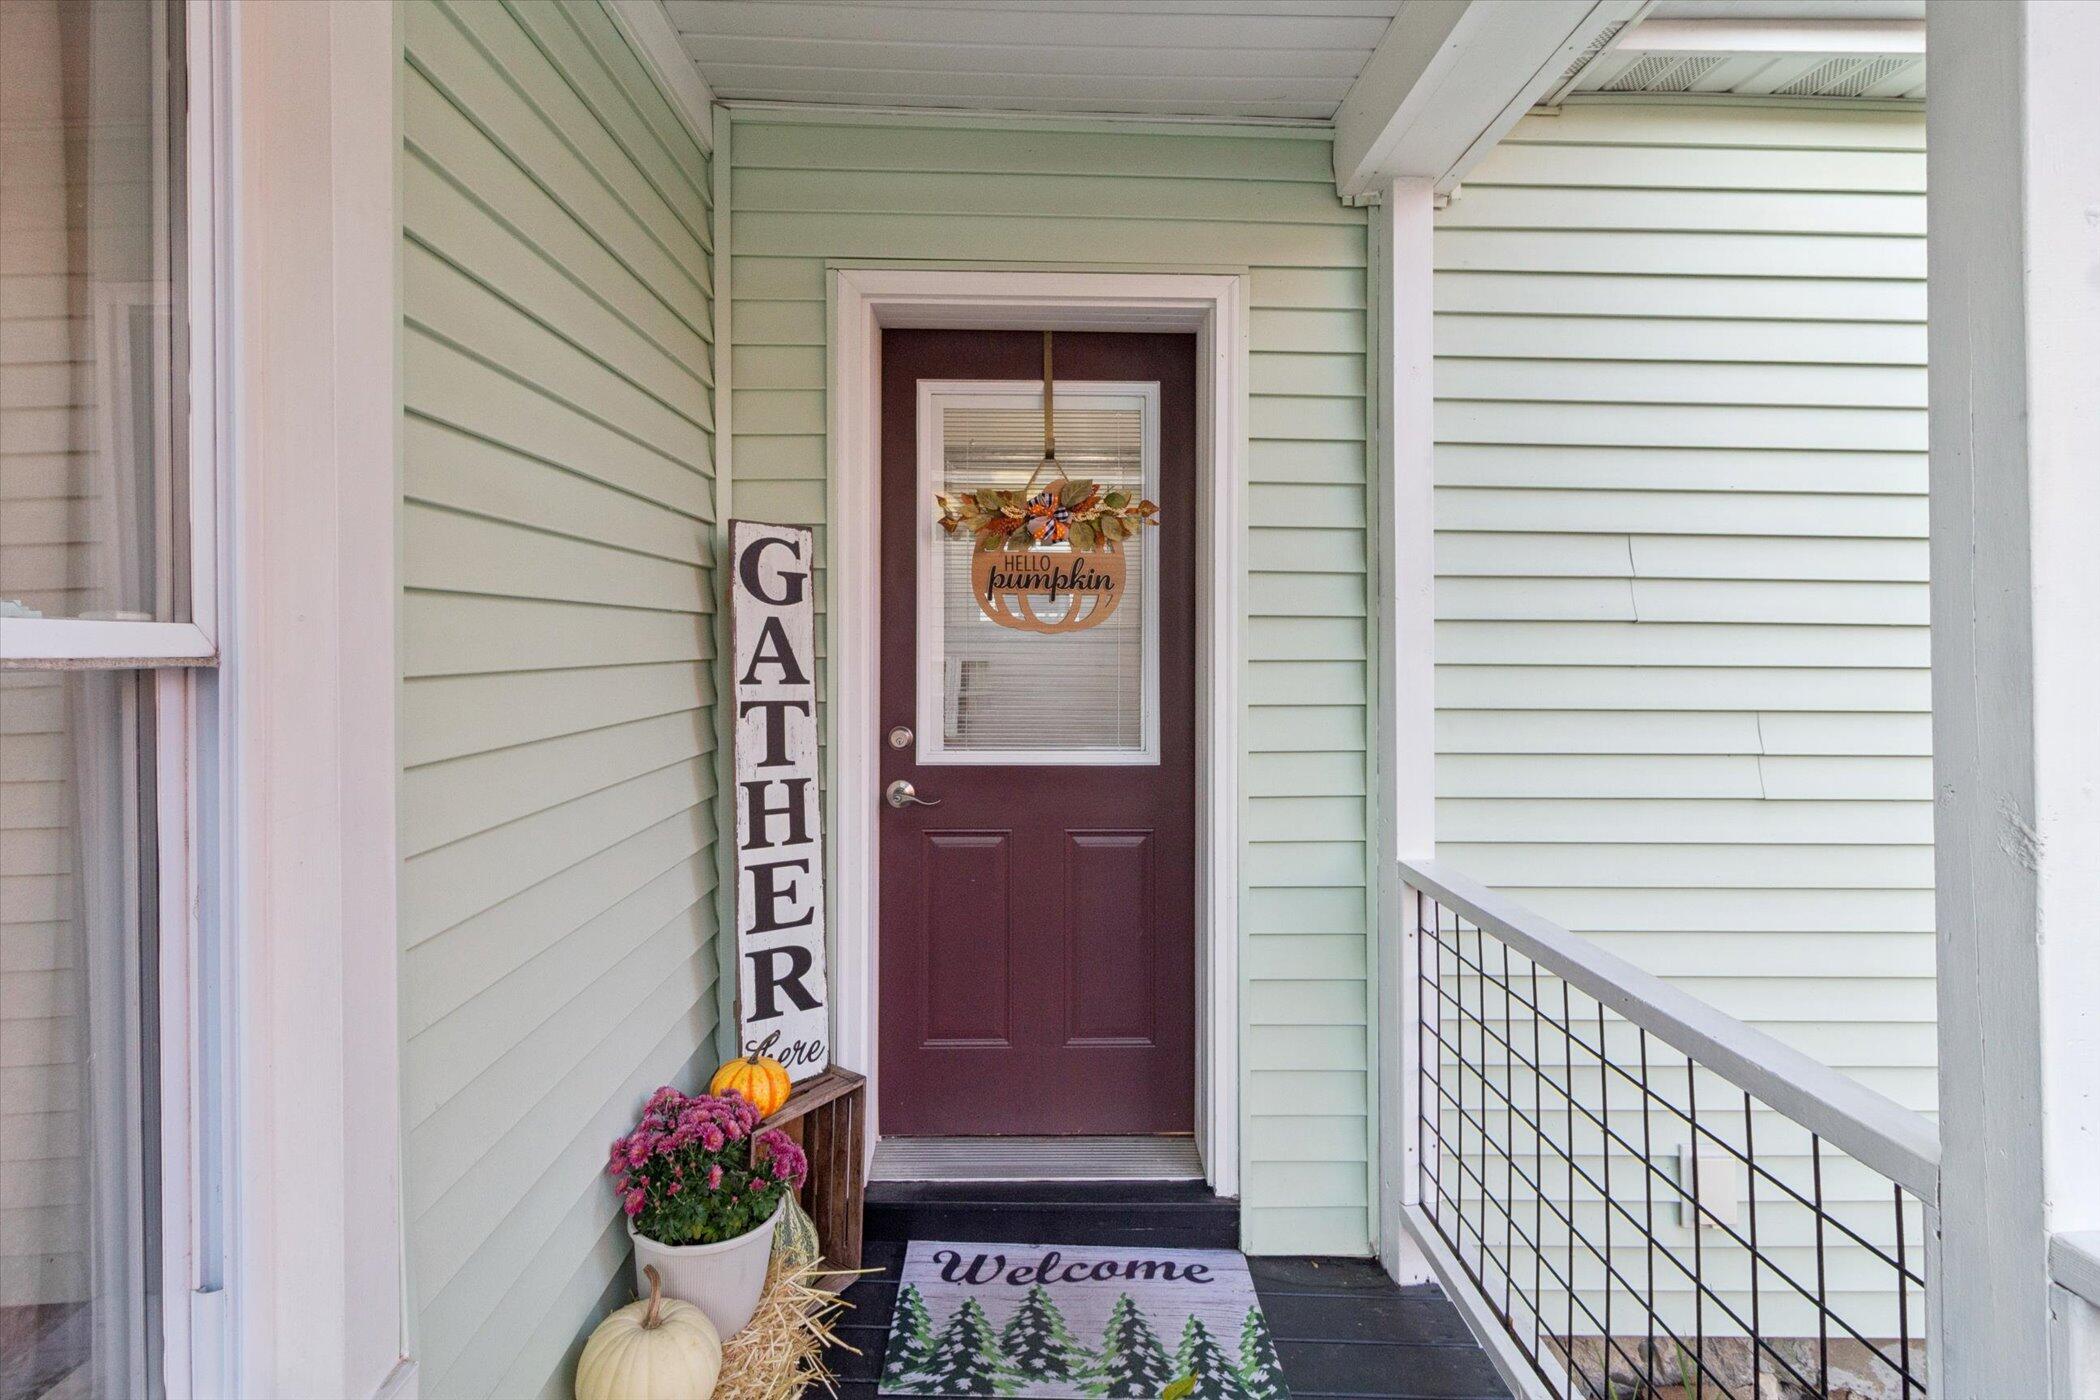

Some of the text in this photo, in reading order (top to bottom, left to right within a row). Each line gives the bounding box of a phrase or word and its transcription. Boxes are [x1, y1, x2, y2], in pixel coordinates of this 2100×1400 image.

[983, 557, 1115, 603] pumpkin
[1004, 555, 1051, 572] HELLO
[739, 536, 823, 1024] GATHER
[932, 1249, 1215, 1286] Welcome
